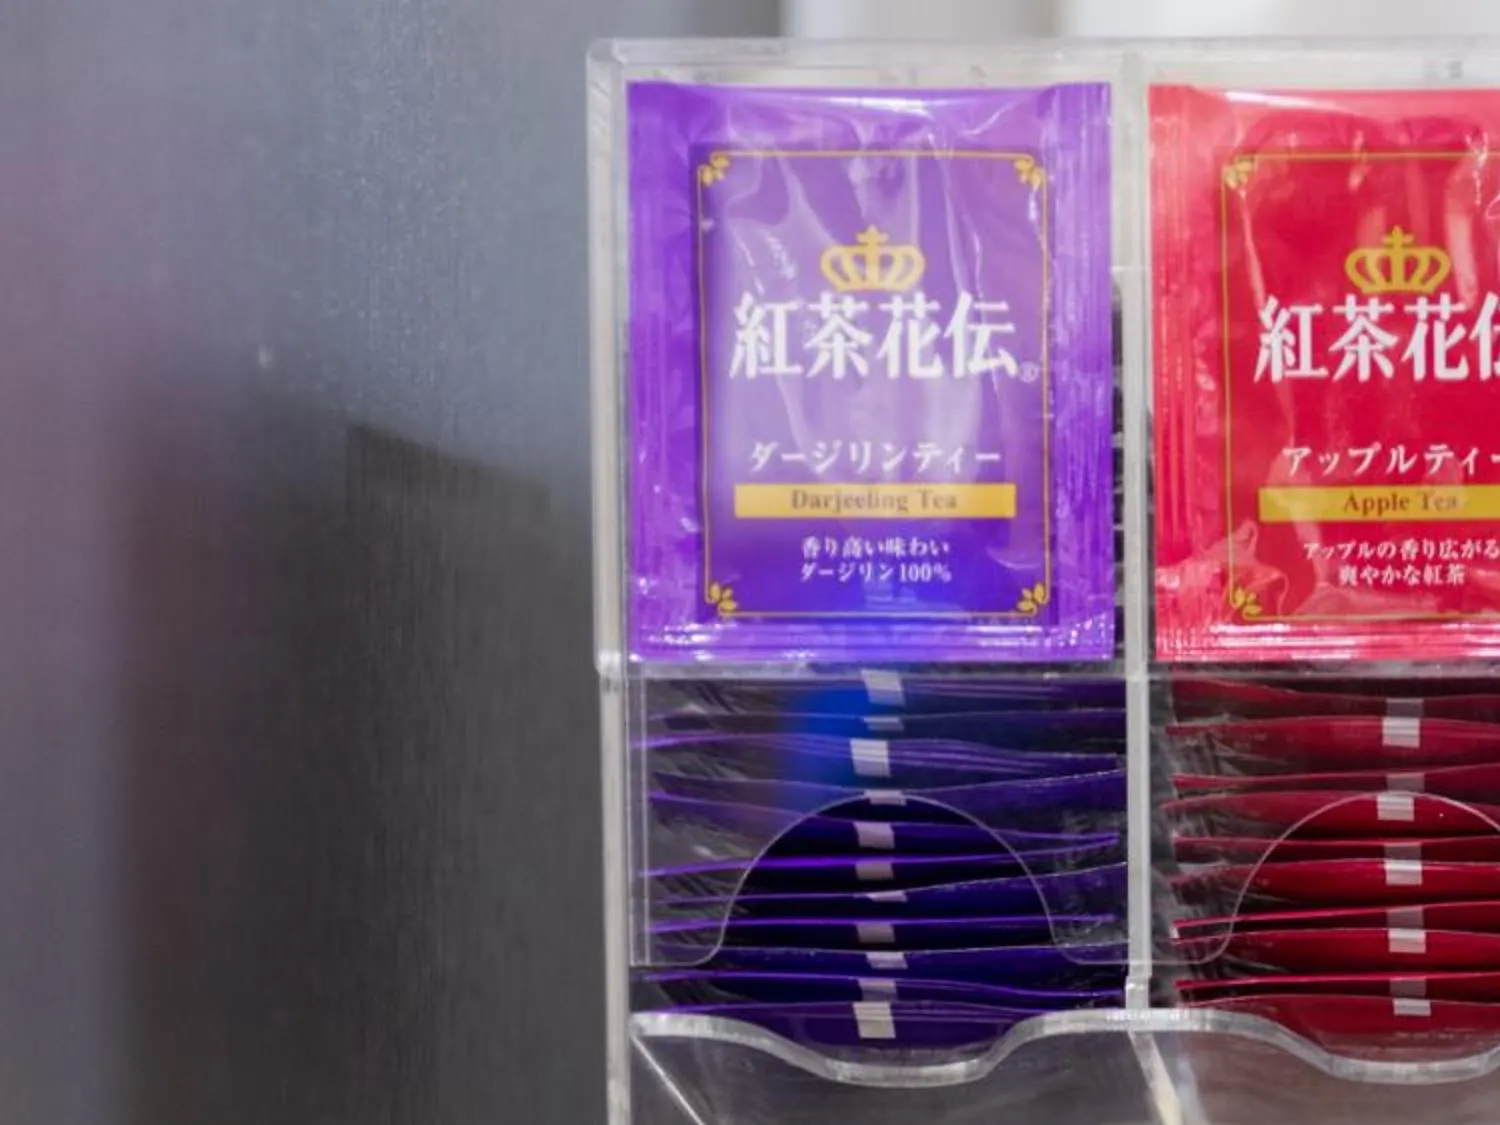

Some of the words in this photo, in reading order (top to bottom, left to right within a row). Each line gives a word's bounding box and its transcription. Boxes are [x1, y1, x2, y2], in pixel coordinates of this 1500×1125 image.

[748, 440, 1001, 474] ダージリンティー
[791, 489, 909, 512] Darjeeling
[918, 489, 957, 510] Tea
[1343, 491, 1410, 516] Apple
[1418, 491, 1458, 510] Tea
[802, 537, 950, 559] 香り高い味わい
[1303, 539, 1500, 561] アップルの香り広がる
[1339, 563, 1466, 586] 爽やかな紅茶
